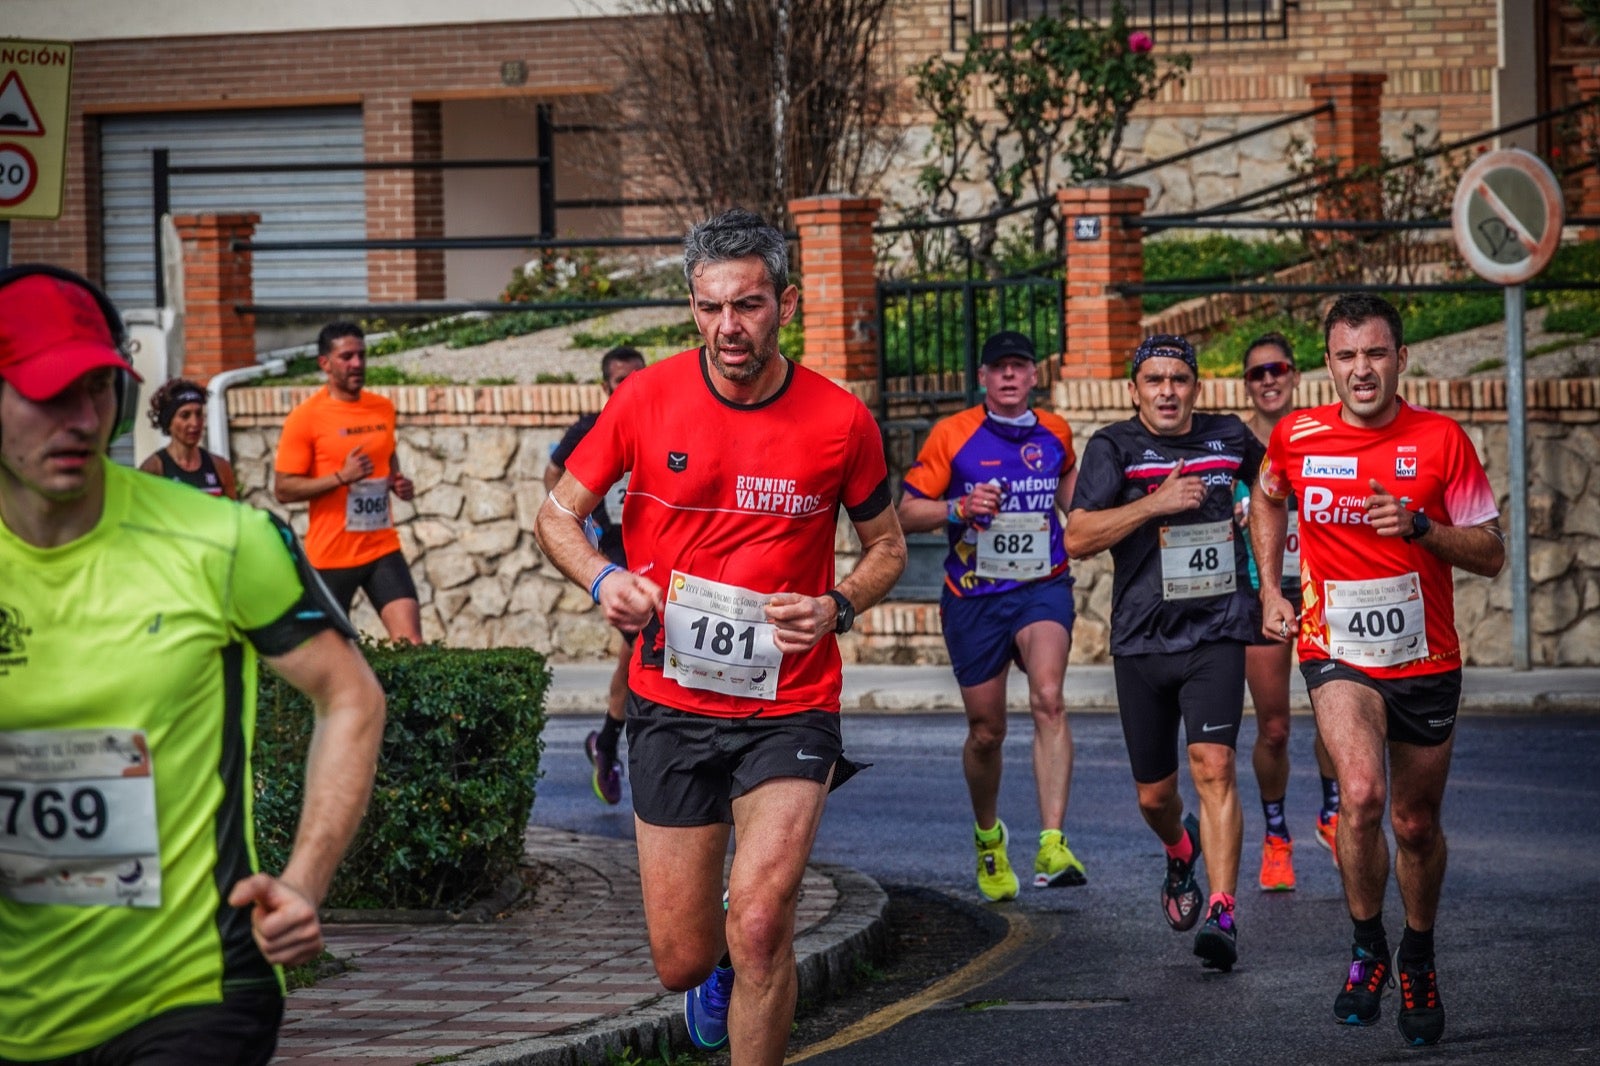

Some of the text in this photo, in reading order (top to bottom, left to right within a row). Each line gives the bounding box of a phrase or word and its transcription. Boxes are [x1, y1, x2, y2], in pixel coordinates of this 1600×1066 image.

[1, 46, 66, 67] NCIÓN
[1396, 468, 1416, 476] MOVE
[1397, 458, 1402, 469] I
[736, 475, 796, 493] RUNNING
[1011, 475, 1059, 493] MÉDUL
[735, 489, 821, 514] VAMPIROS
[1025, 493, 1055, 511] VID
[1338, 496, 1367, 508] Clíni
[993, 533, 1034, 554] 682
[1188, 547, 1219, 571] 48
[1348, 607, 1405, 637] 400
[690, 615, 756, 660] 181
[0, 786, 109, 841] 769
